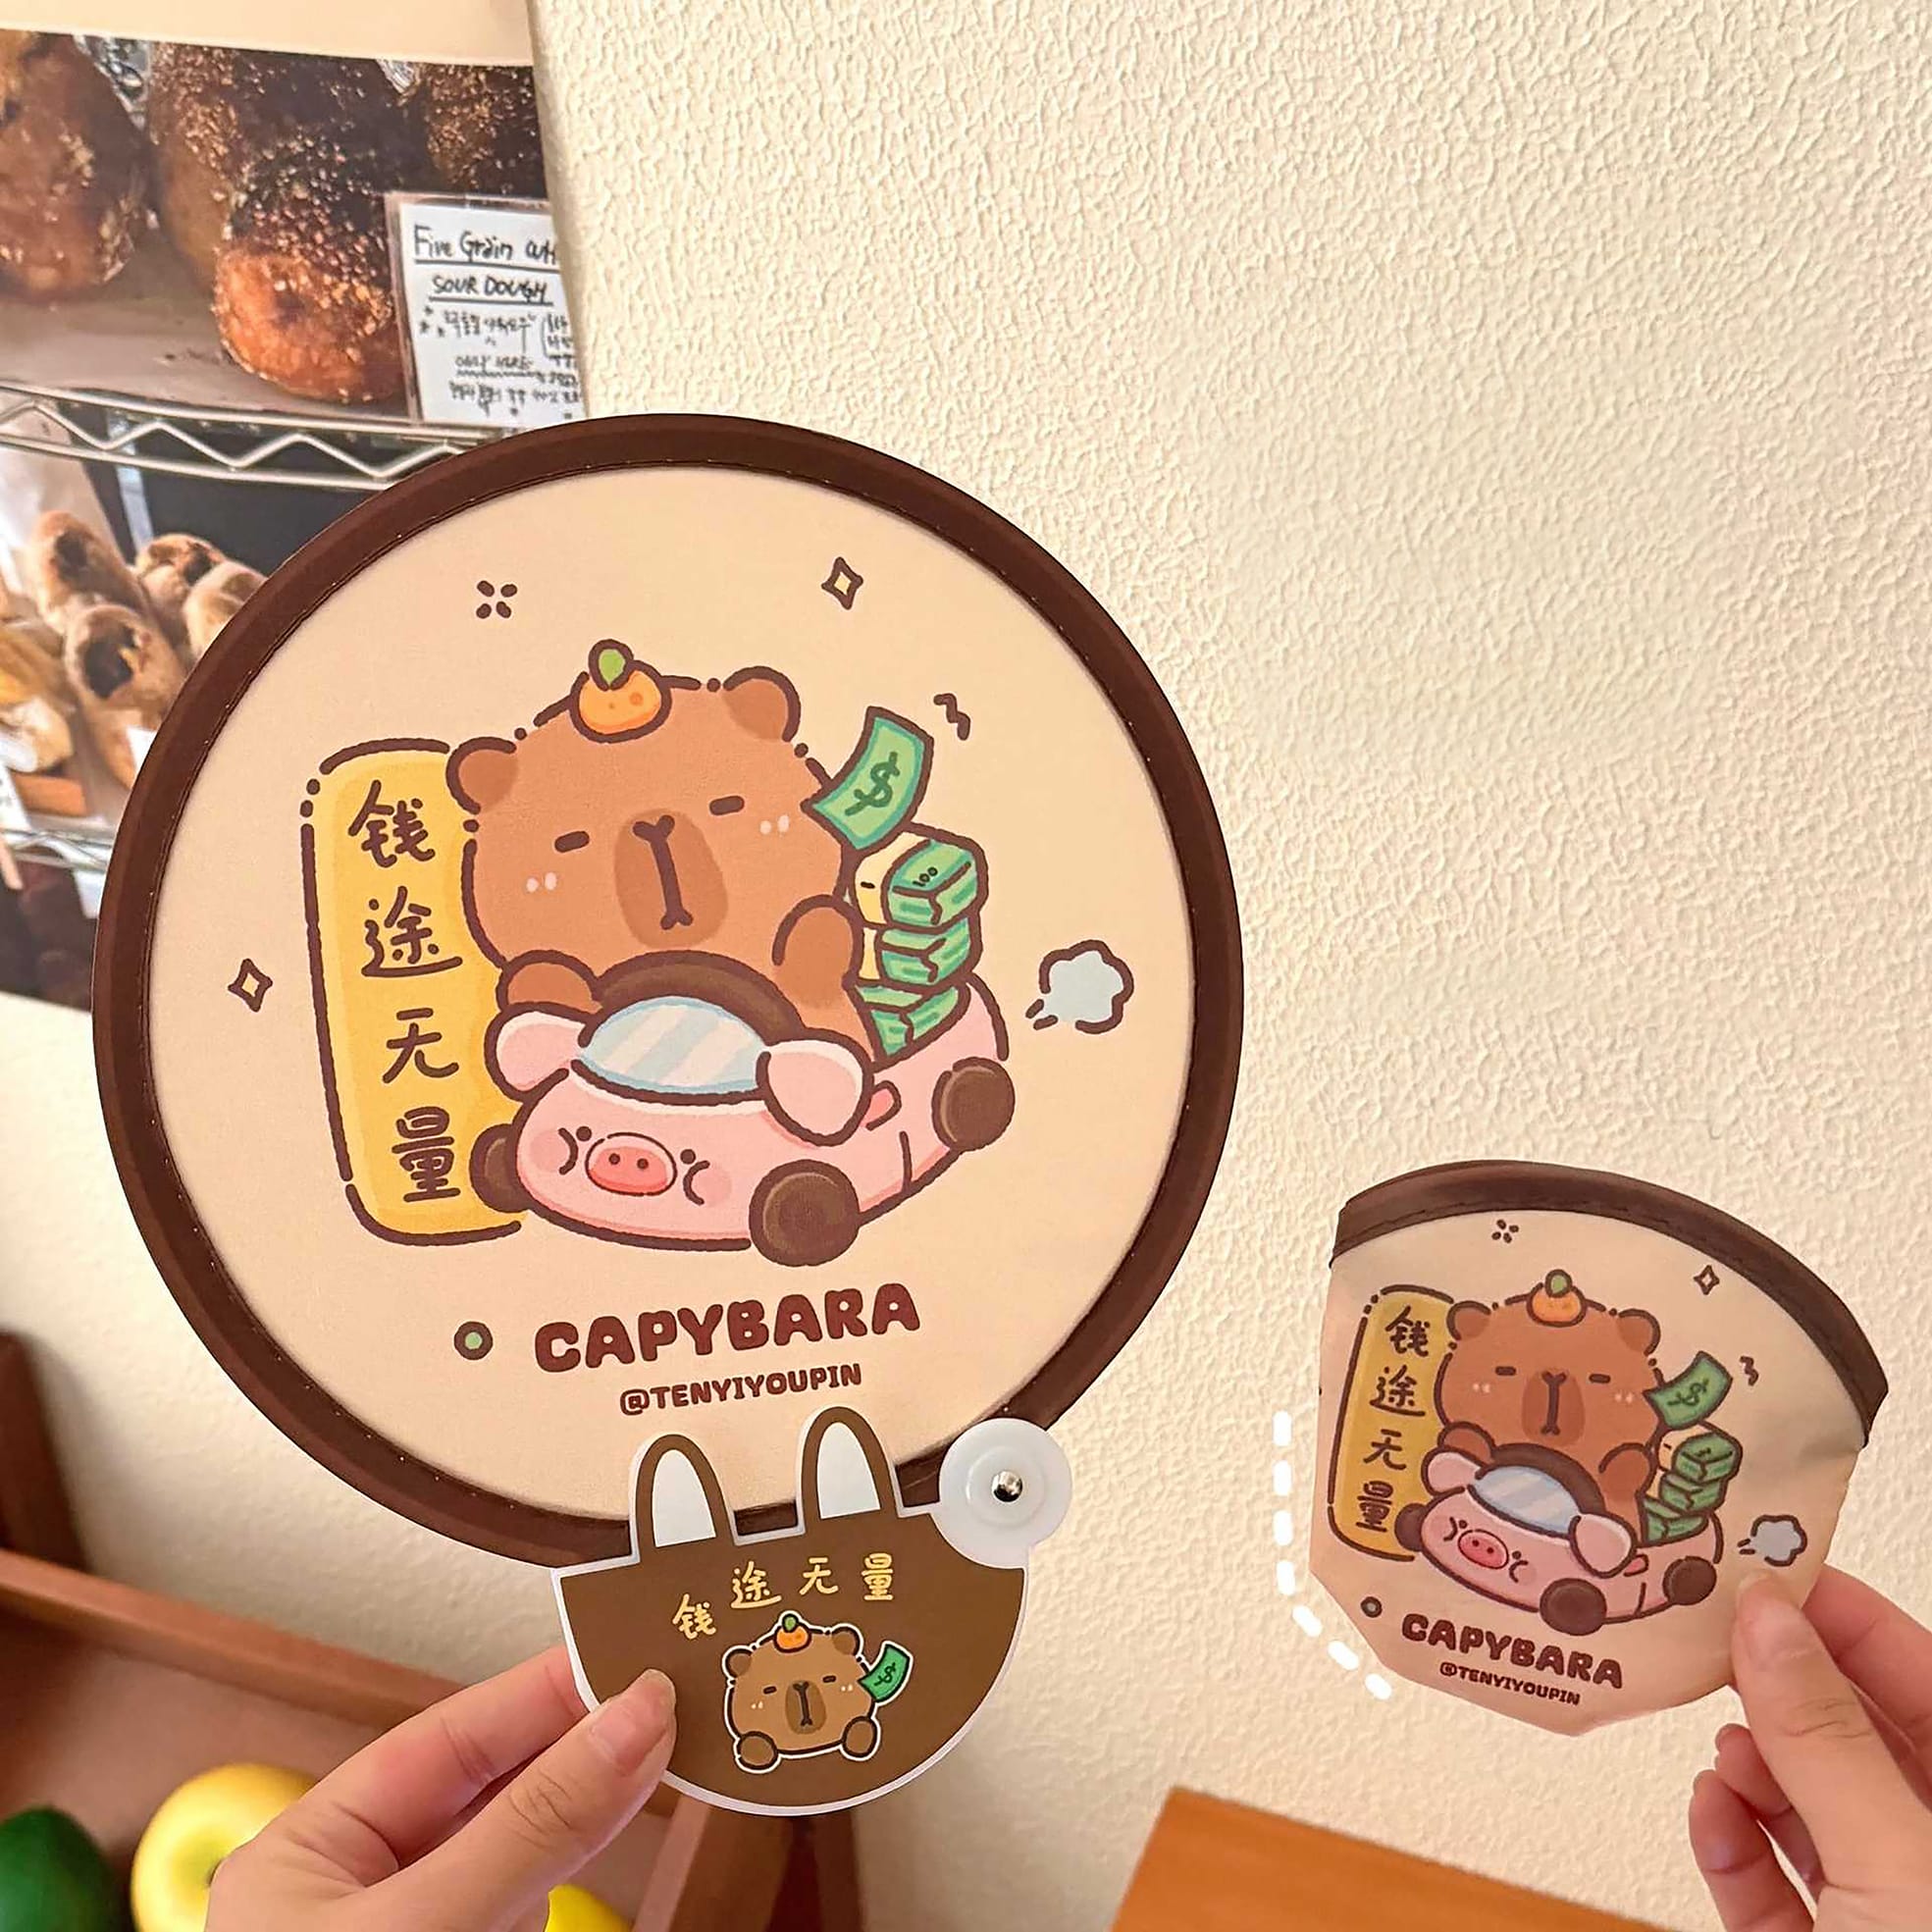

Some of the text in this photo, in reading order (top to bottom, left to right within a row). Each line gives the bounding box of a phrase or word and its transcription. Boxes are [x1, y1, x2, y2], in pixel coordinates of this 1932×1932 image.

[414, 224, 452, 257] Five
[459, 230, 513, 261] Grain
[432, 274, 548, 303] SOUR DOUGH
[347, 779, 463, 1203] 钱途无量
[534, 1282, 920, 1373] CAPYBARA
[619, 1363, 862, 1416] @TENYIYOUPIN
[1355, 1305, 1431, 1533] 钱途无量
[672, 1552, 894, 1640] 钱途无量
[1401, 1613, 1623, 1689] CAPYBARA
[1439, 1661, 1581, 1705] @TENYIYOUPIN
